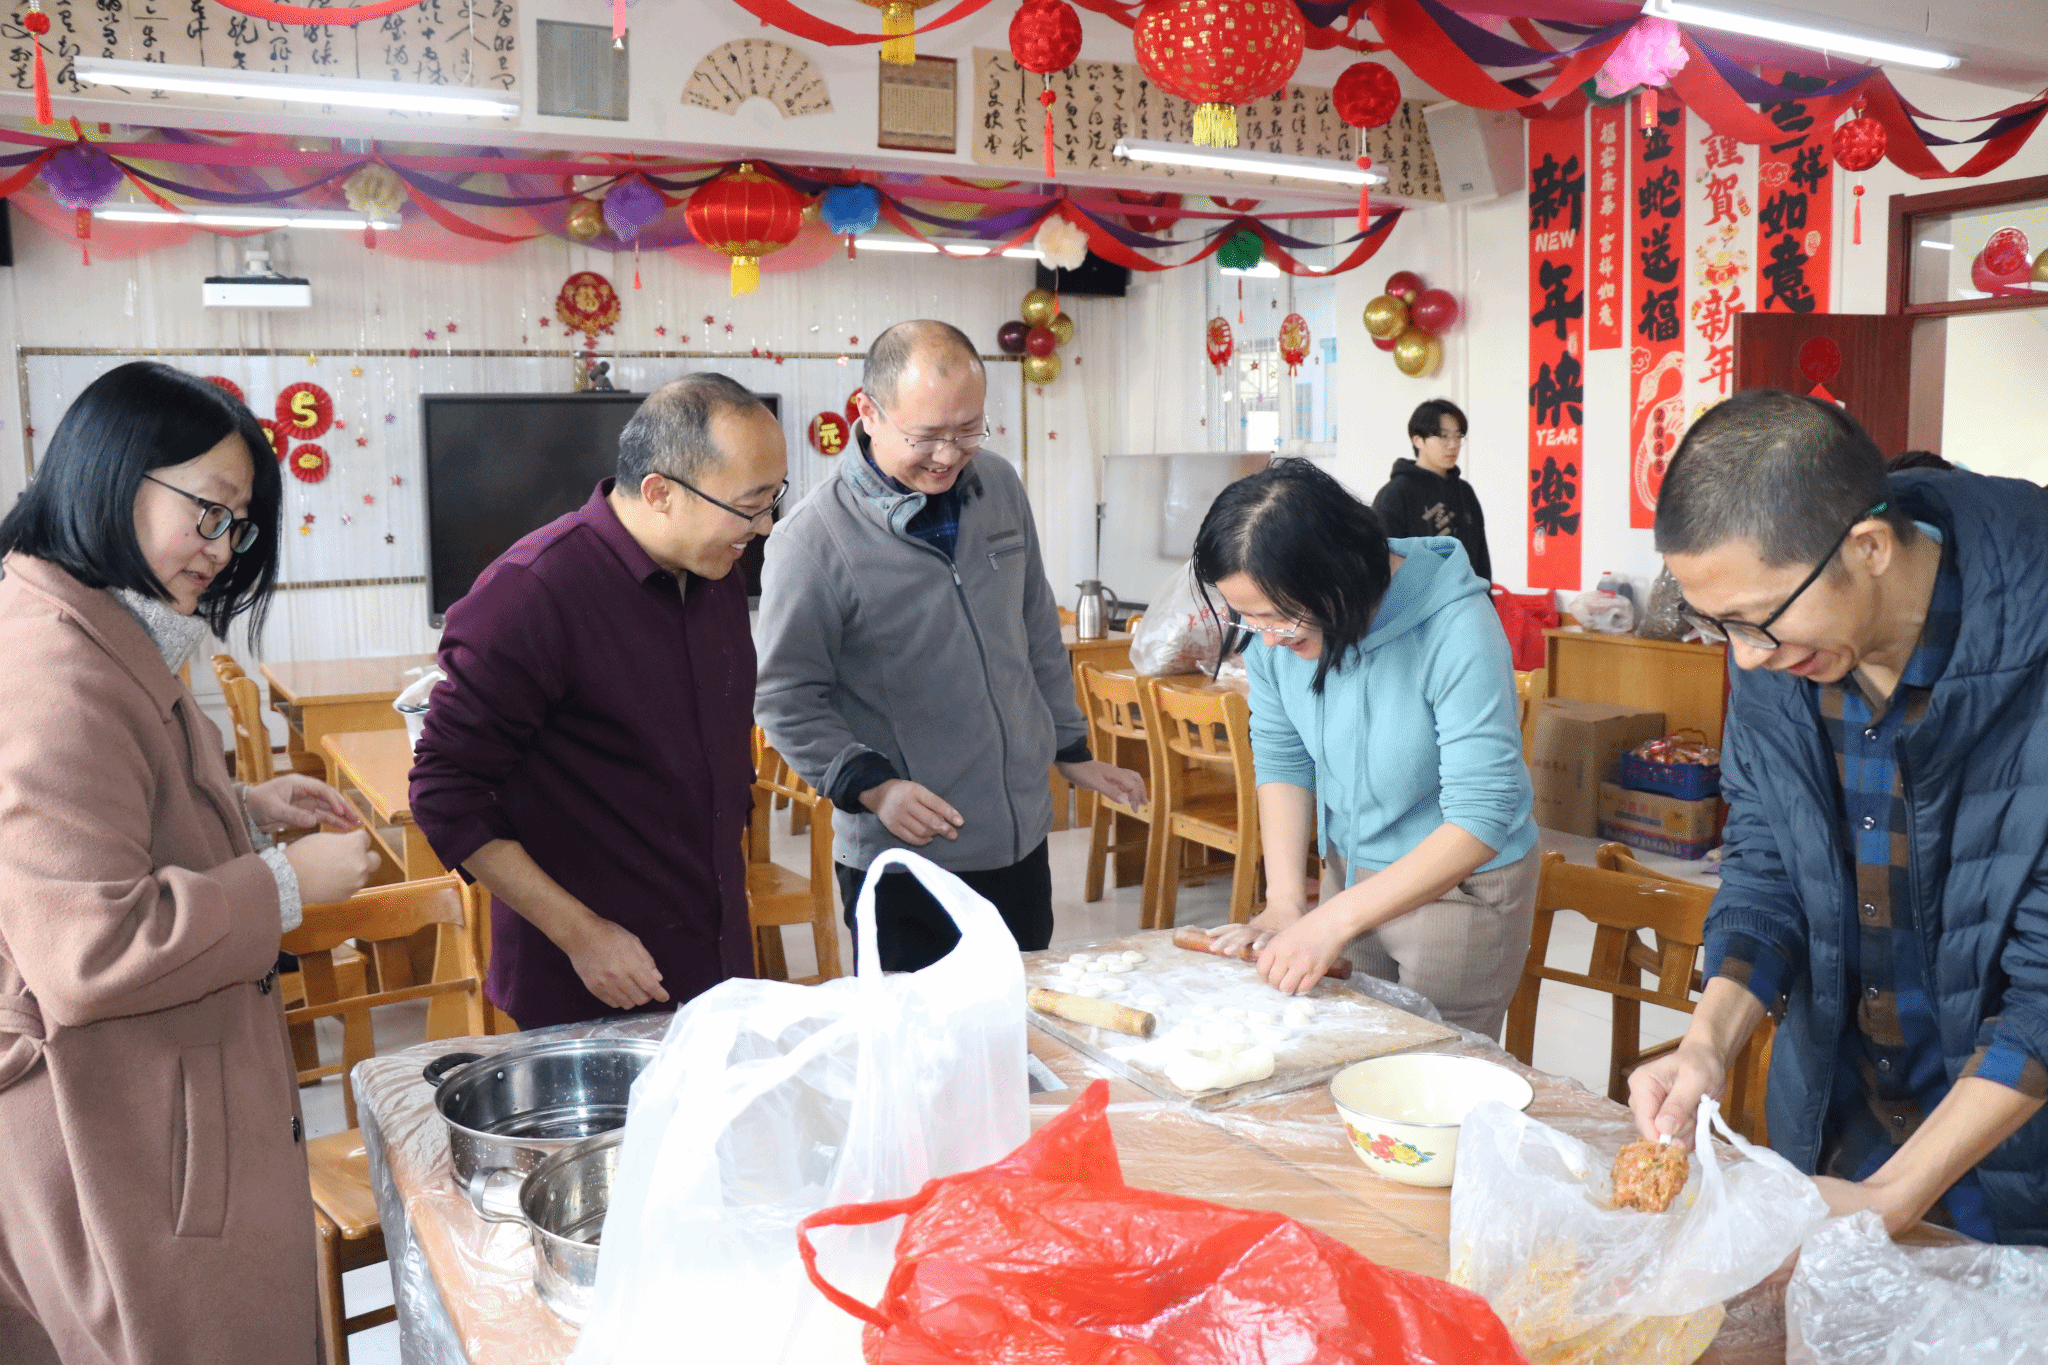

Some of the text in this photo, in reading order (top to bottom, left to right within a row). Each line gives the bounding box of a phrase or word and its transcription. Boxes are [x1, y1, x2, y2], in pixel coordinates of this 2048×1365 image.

[1638, 107, 1681, 342] 金蛇送福
[1535, 228, 1576, 253] NEW
[819, 422, 842, 447] 元
[1535, 427, 1578, 447] YEAR
